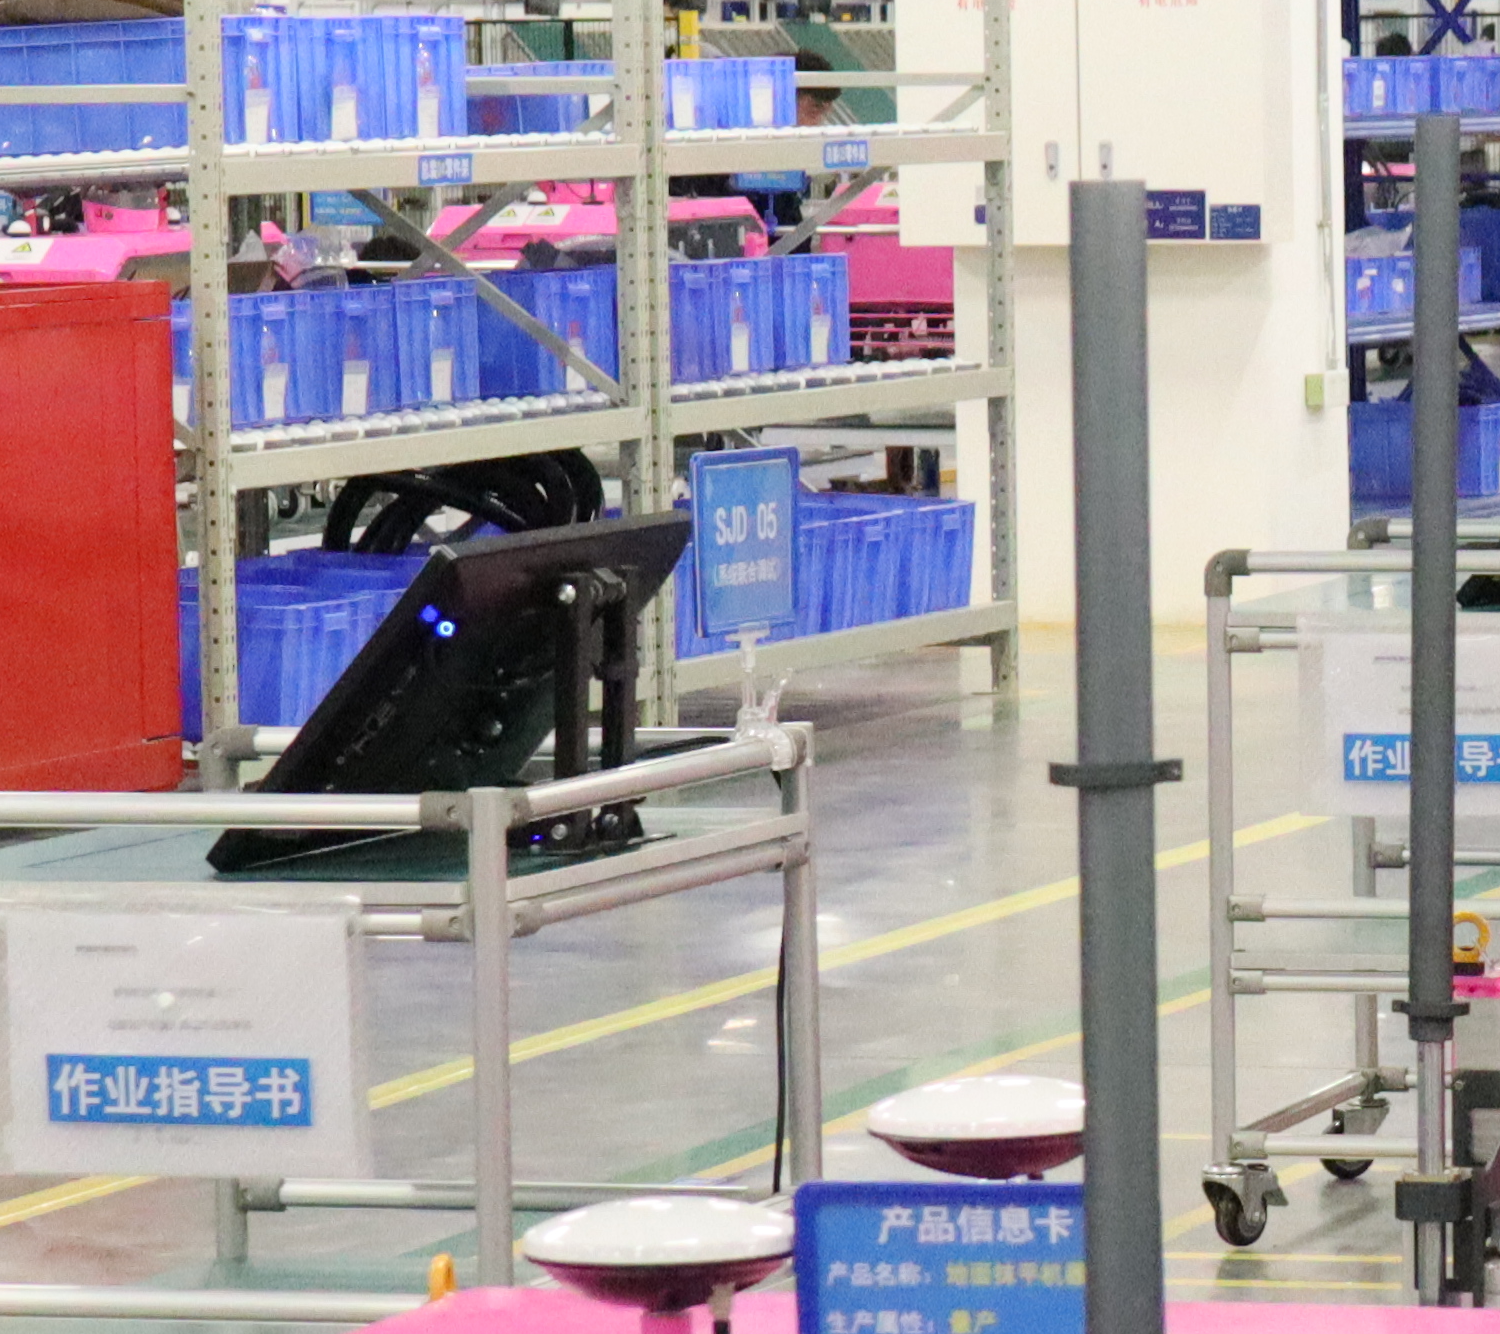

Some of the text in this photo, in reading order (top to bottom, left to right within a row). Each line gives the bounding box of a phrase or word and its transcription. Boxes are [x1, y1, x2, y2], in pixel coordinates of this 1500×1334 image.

[715, 502, 778, 546] SJD 05
[53, 1062, 301, 1120] 作业指导书
[877, 1205, 1074, 1245] 产品信息卡
